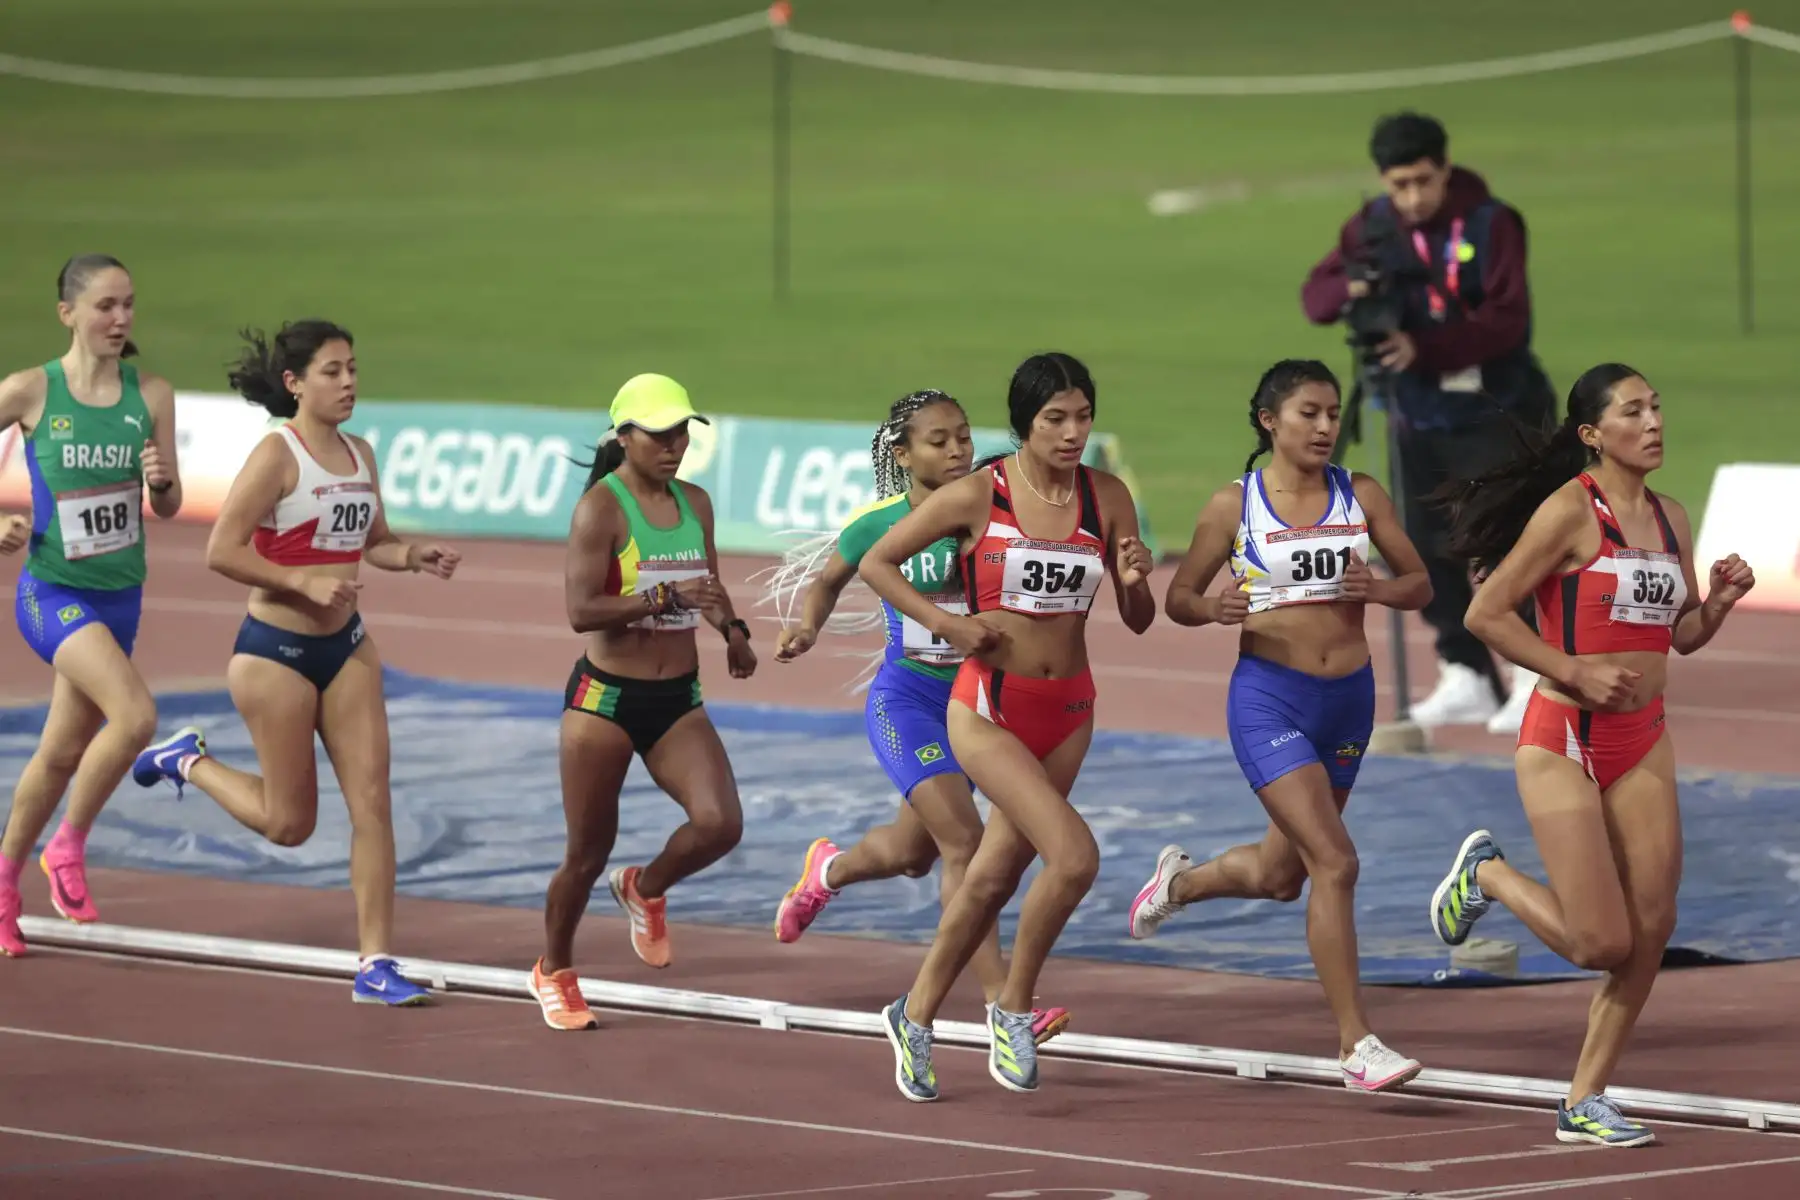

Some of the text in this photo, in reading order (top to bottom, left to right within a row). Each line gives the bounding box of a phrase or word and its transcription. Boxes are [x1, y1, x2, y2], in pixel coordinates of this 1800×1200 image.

[62, 444, 133, 469] BRASIL
[78, 502, 128, 537] 168
[331, 502, 370, 532] 203
[1021, 560, 1086, 594] 354
[1291, 546, 1350, 582] 301
[1632, 569, 1676, 606] 352
